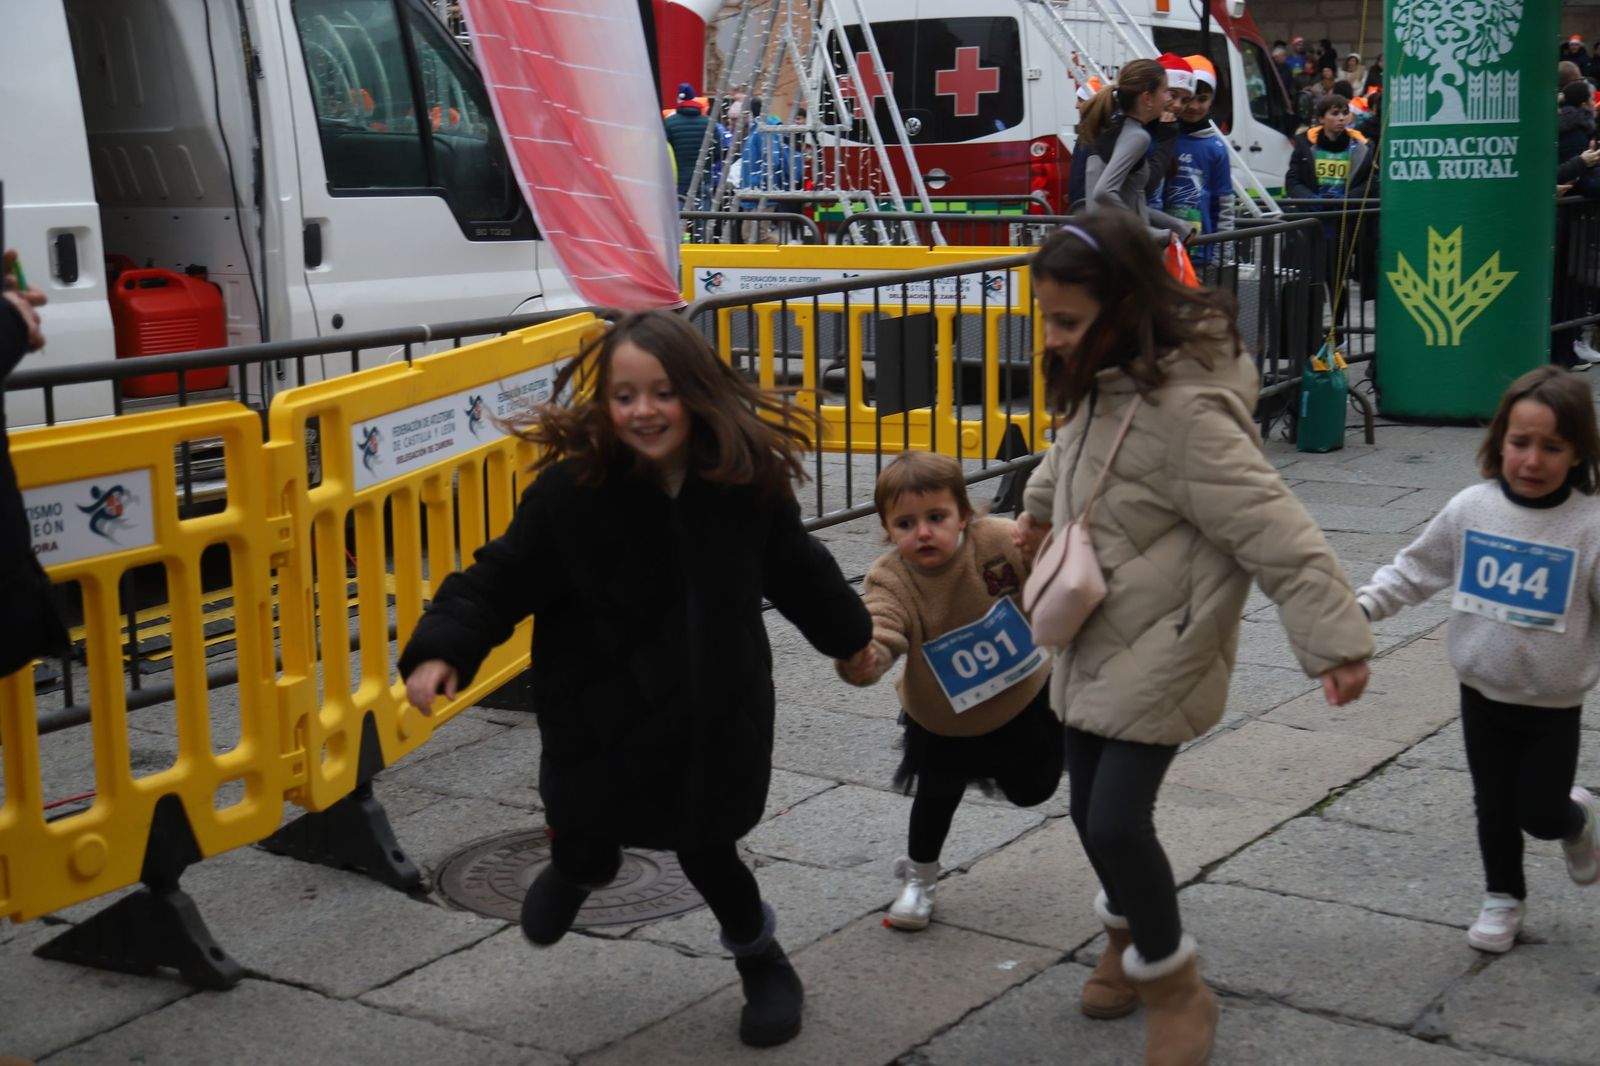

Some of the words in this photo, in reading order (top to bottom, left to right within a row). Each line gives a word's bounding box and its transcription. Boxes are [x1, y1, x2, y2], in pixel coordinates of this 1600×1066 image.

[1389, 136, 1520, 158] FUNDACION
[1317, 162, 1347, 178] 590
[1388, 160, 1433, 181] CAJA
[1437, 158, 1519, 180] RURAL
[33, 519, 64, 537] EÓN
[33, 541, 58, 554] ORA
[1476, 555, 1550, 600] 044
[951, 629, 1018, 679] 091
